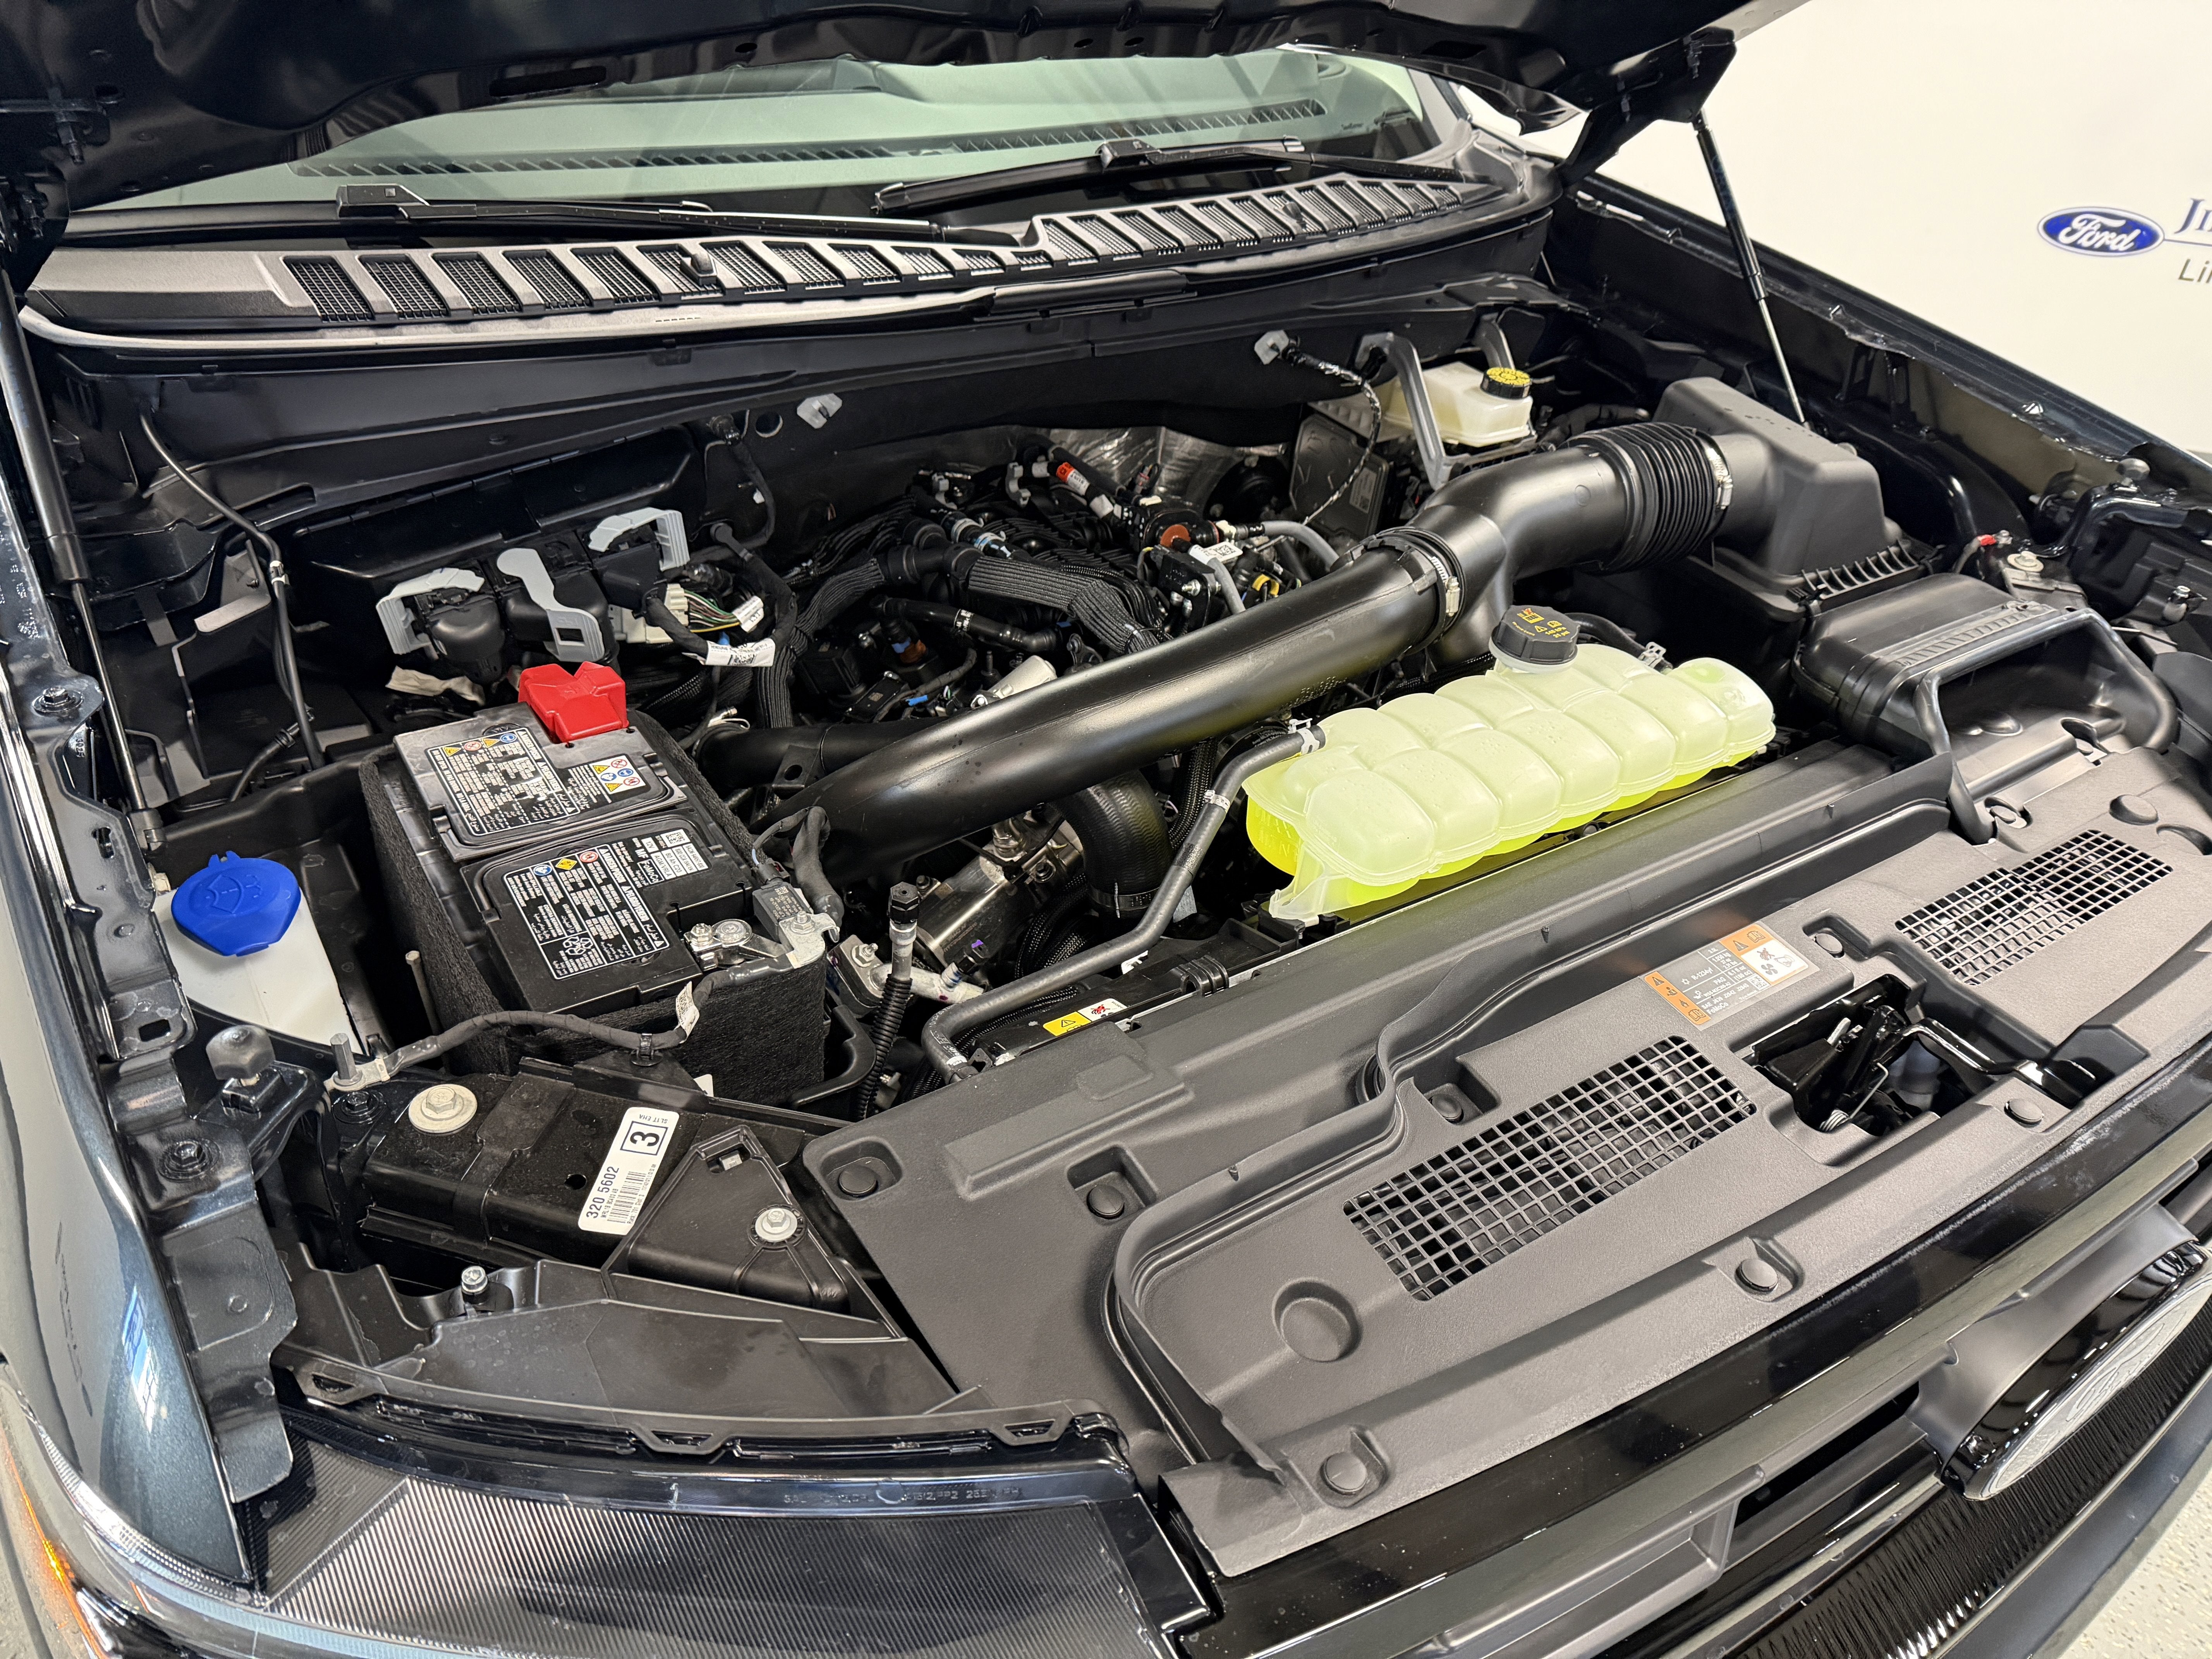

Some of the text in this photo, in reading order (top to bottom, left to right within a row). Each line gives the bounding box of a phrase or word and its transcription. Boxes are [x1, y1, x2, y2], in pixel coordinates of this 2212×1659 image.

[2174, 198, 2212, 234] JI
[2058, 213, 2142, 251] Ford
[635, 849, 649, 858] MF
[641, 860, 659, 882] FoMoCo
[654, 855, 672, 877] AGM/VRLA
[1691, 967, 1714, 981] R-1234yf
[1713, 977, 1726, 985] PAG
[1706, 1002, 1729, 1015] FoMoCo
[630, 1132, 659, 1146] 3
[586, 1166, 619, 1218] 320 5602
